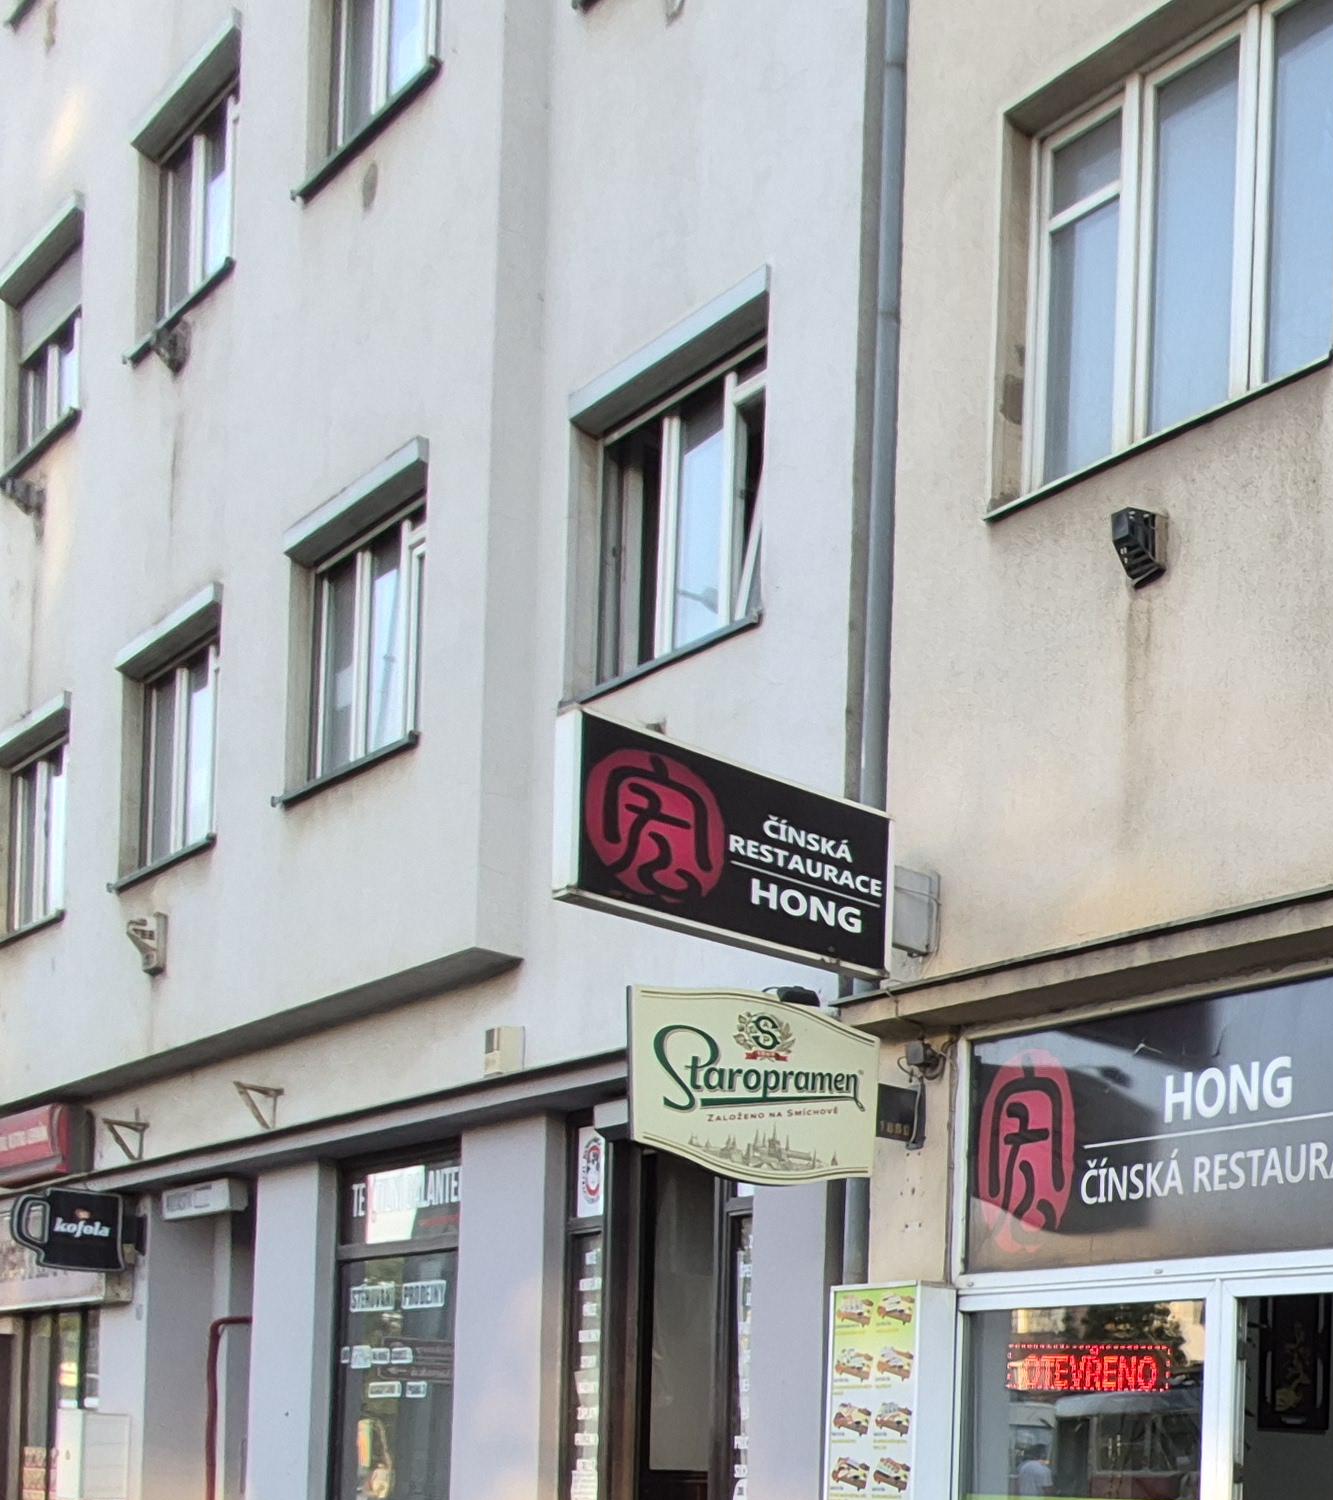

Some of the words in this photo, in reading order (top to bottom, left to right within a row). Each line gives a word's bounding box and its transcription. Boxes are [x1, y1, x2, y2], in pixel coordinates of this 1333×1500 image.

[729, 834, 882, 897] RESTAURACE
[762, 814, 851, 863] ČÍNSKÁ
[751, 879, 862, 933] HONG
[653, 1024, 865, 1112] Staropramen
[1163, 1056, 1293, 1124] HONG
[769, 1110, 782, 1118] NA
[1080, 1149, 1183, 1205] ČÍNSKÁ
[54, 1217, 111, 1238] kofola
[1022, 1347, 1158, 1390] OTEVŘENO
